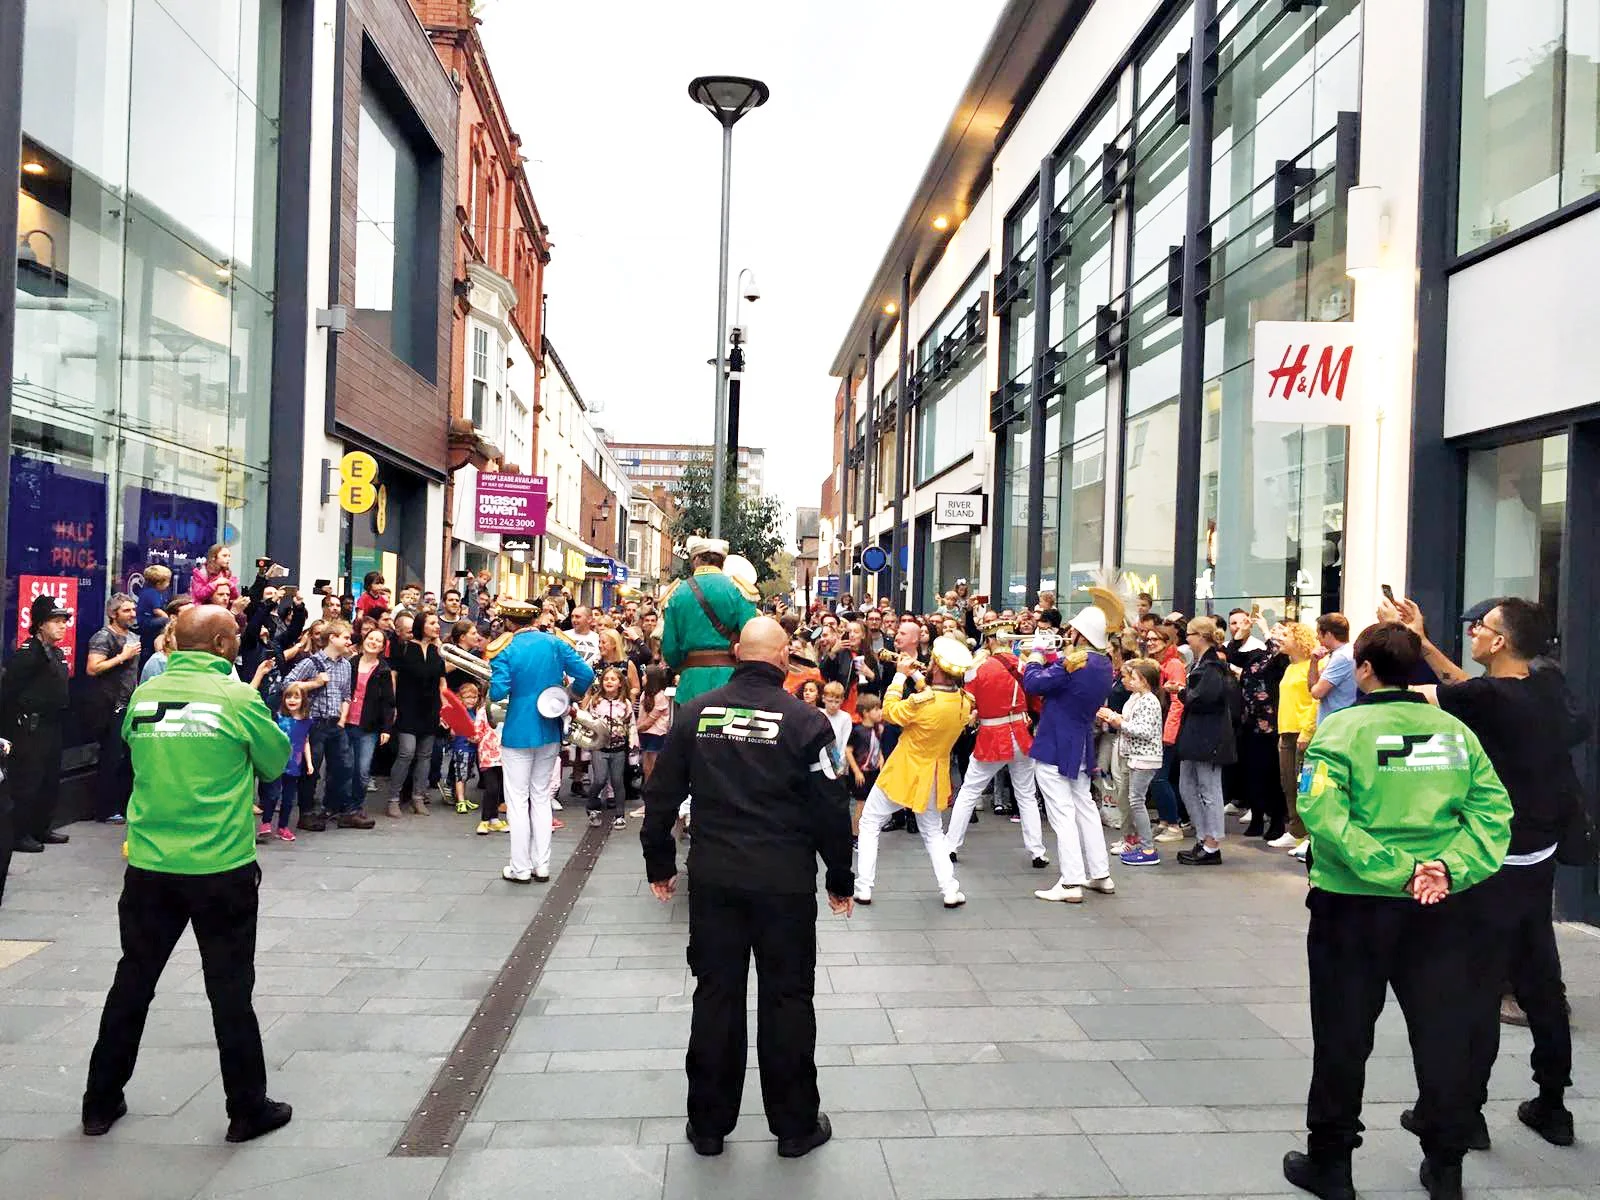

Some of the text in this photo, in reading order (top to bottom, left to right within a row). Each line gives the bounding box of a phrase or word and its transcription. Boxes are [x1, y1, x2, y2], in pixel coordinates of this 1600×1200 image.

[1268, 344, 1354, 401] H&M
[481, 473, 544, 485] SHOP LEASE AVAILABLE
[479, 494, 528, 507] mason
[948, 500, 971, 509] RIVER
[479, 516, 536, 528] 0151 242 3000
[944, 509, 975, 518] ISLAND
[54, 520, 94, 541] HALF
[51, 547, 96, 569] PRICE
[31, 581, 68, 603] SALE
[697, 706, 784, 740] PES
